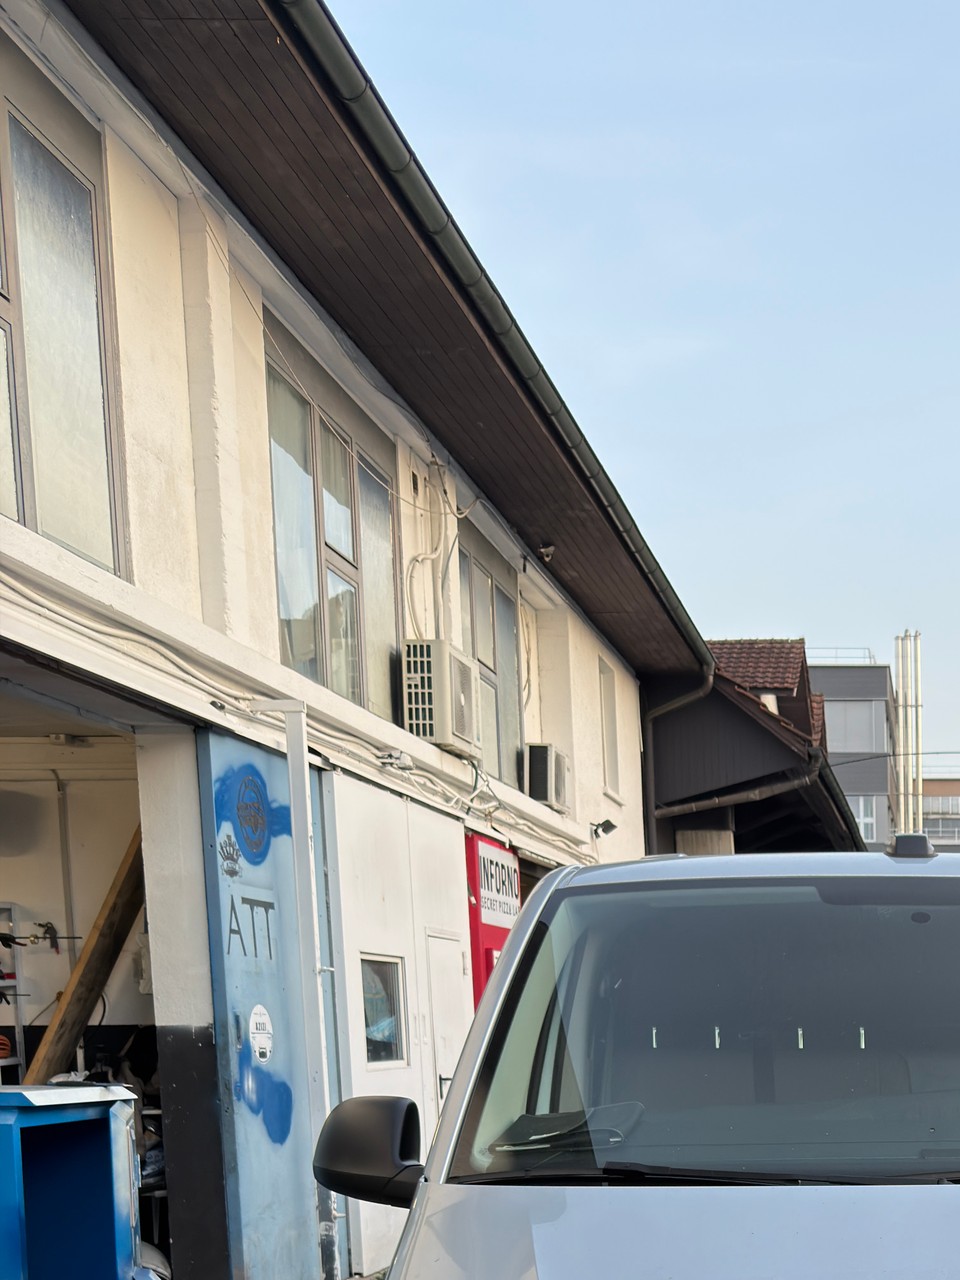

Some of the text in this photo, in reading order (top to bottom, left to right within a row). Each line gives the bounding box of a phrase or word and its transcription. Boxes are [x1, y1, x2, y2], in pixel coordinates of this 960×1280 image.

[480, 855, 519, 899] INFORNO
[481, 896, 498, 912] SECRET
[227, 894, 275, 960] ATT
